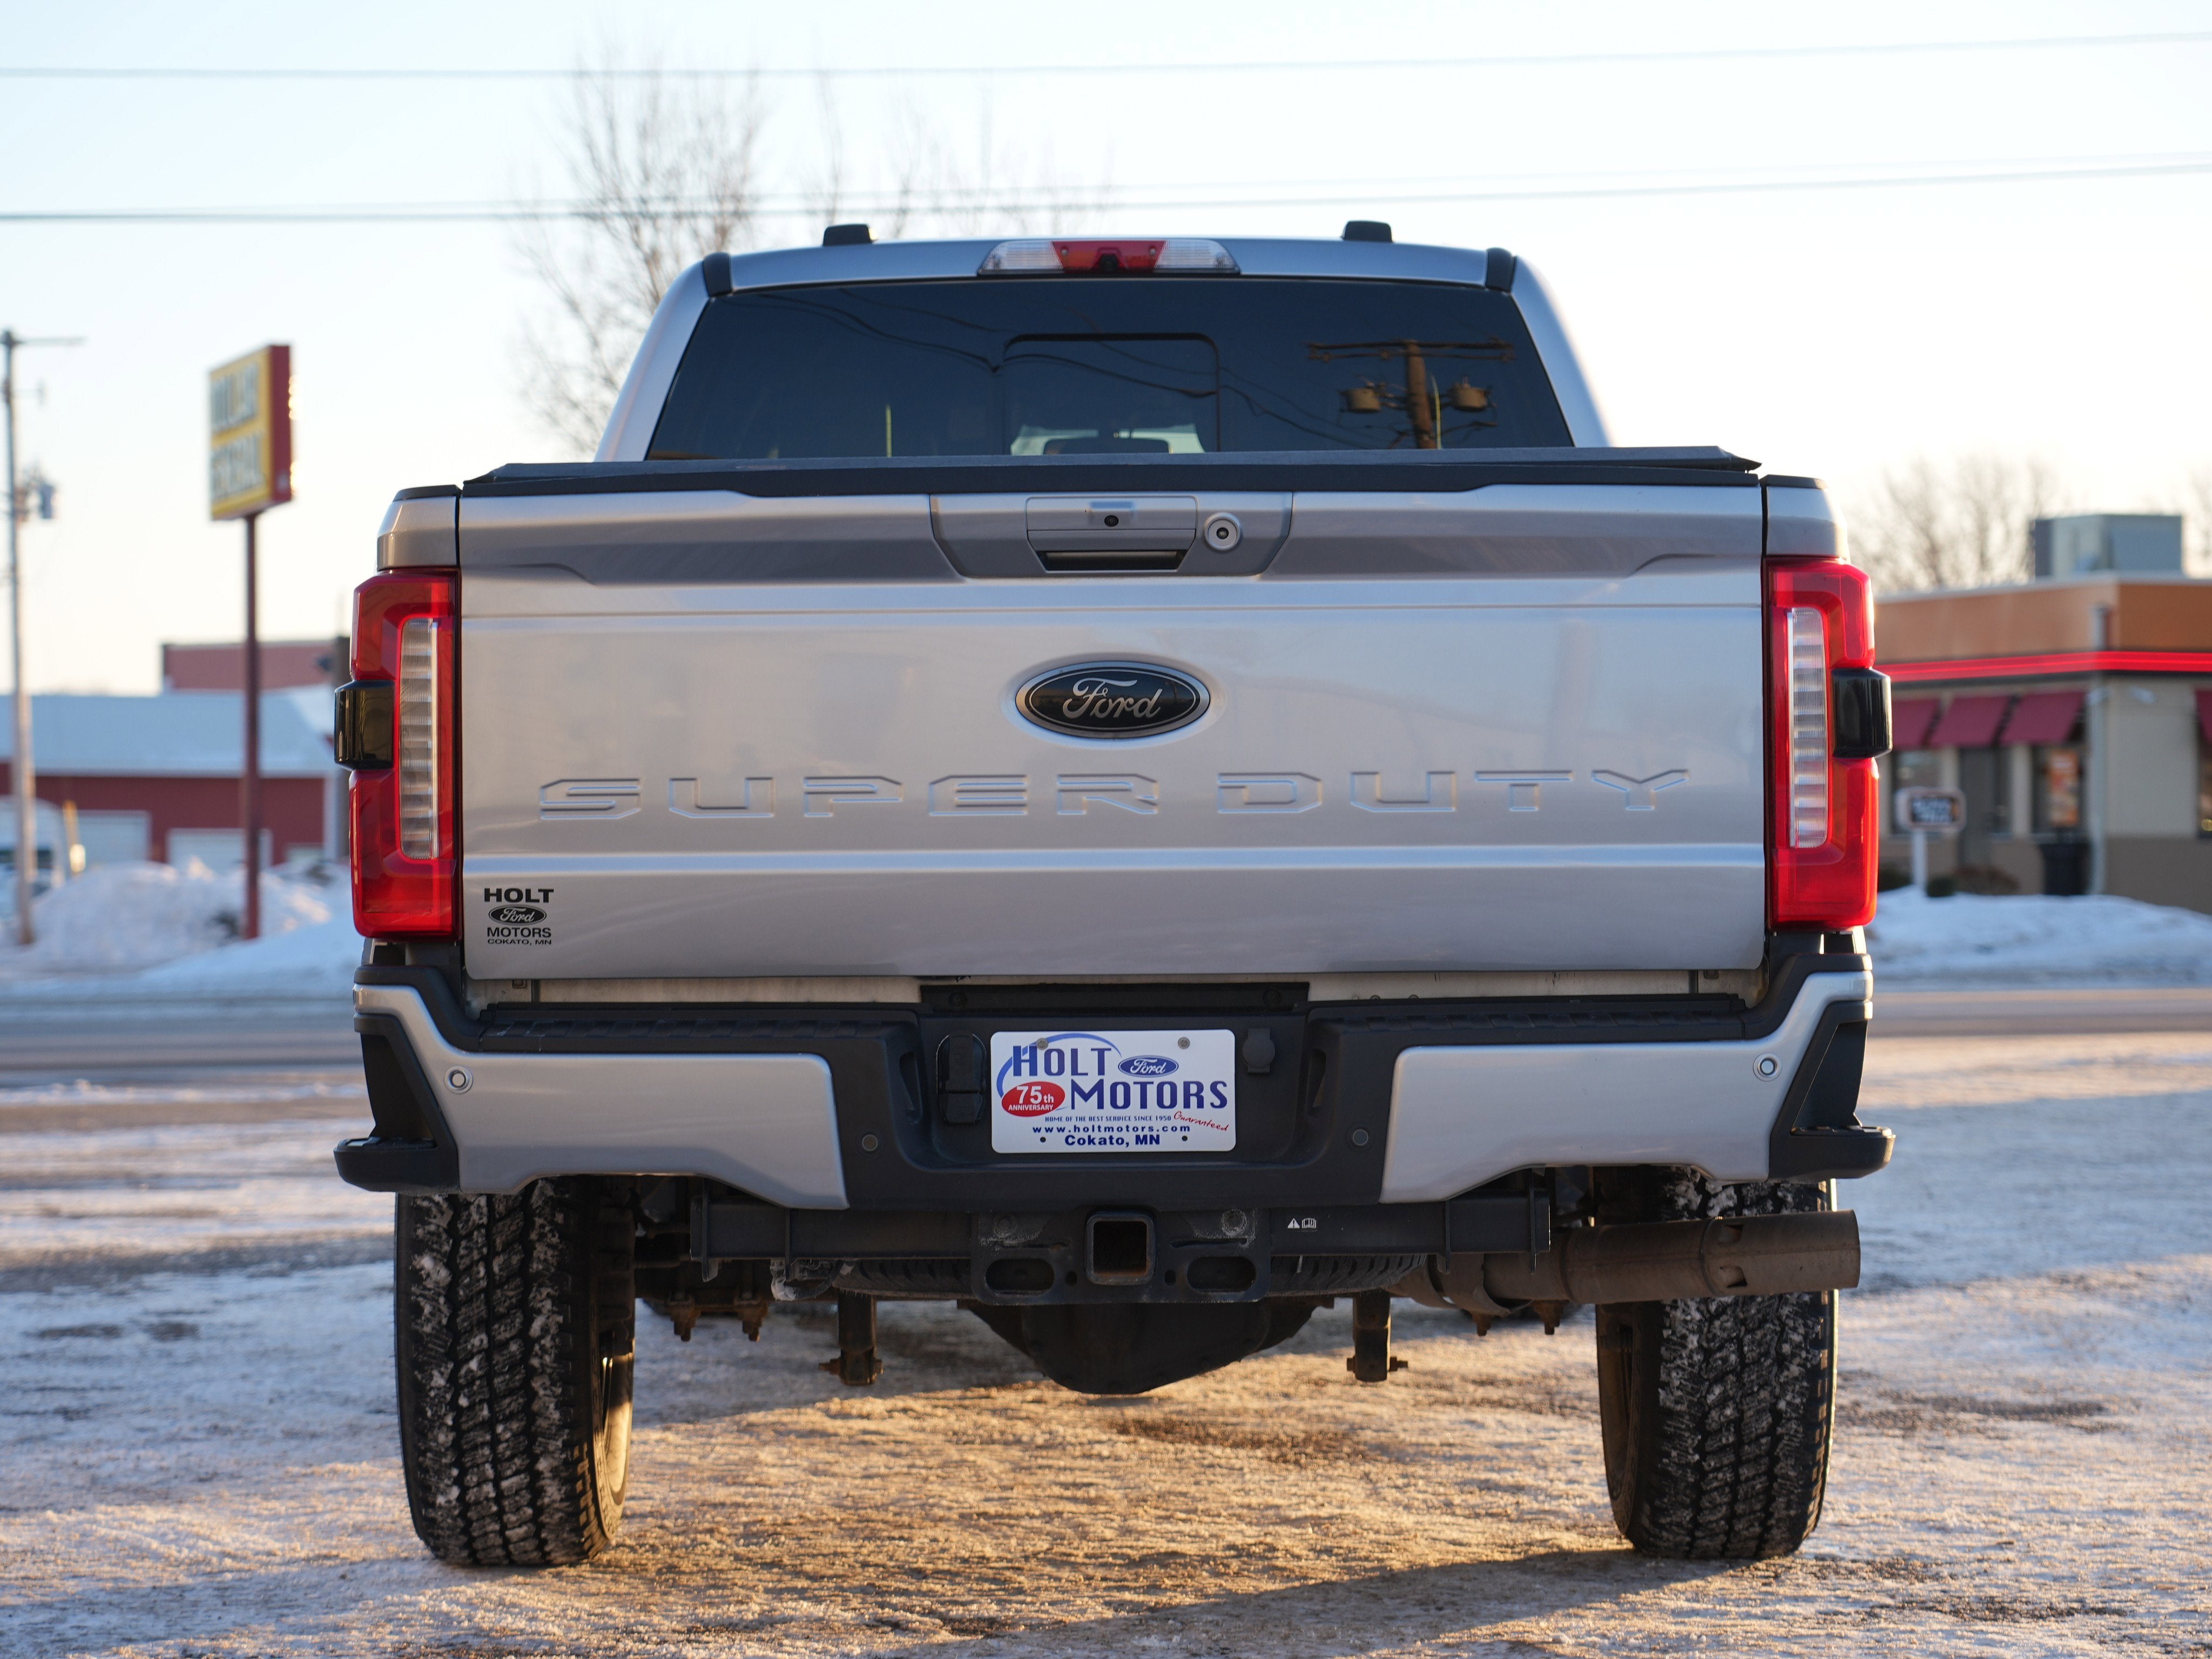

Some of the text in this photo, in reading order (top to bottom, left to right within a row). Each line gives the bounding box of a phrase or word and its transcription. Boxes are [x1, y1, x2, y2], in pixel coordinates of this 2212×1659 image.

[1062, 677, 1163, 719] Ford
[539, 769, 1689, 819] SUPER DUTY
[484, 888, 554, 903] HOLT
[500, 907, 535, 922] Ford
[487, 927, 552, 938] MOTORS
[1013, 1045, 1112, 1077] HOLT
[1130, 1058, 1167, 1074] Ford
[1016, 1085, 1054, 1105] 75th
[1070, 1078, 1228, 1110] MOTORS
[1033, 1124, 1190, 1133] www.holtmotors.com
[1174, 1110, 1229, 1132] Guaranteed
[1064, 1134, 1161, 1148] Cokato, MN
